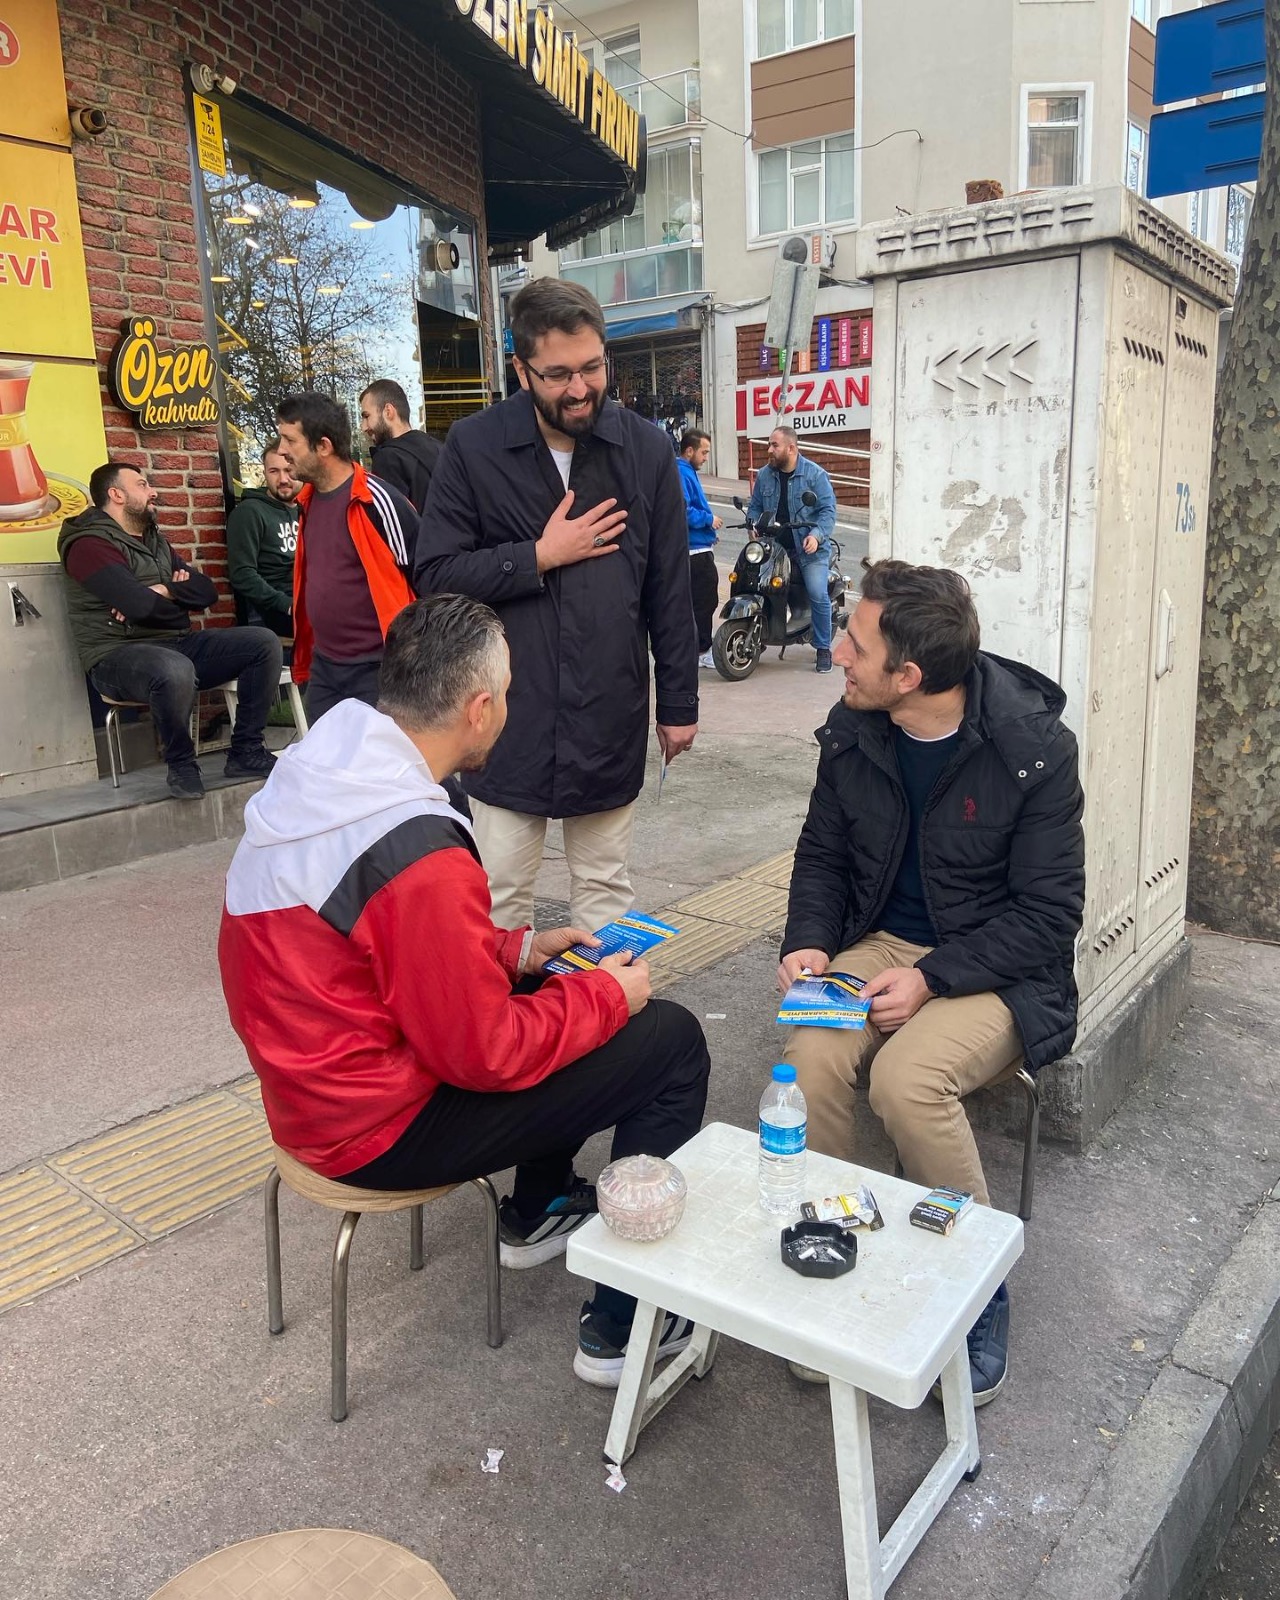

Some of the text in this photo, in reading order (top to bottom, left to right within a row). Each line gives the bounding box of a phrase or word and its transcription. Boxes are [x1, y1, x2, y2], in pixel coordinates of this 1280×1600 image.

[454, 0, 640, 172] EN SİMİT FIRINI
[0, 203, 61, 244] AR
[861, 326, 869, 354] MEDİKAL
[120, 320, 213, 406] Özen
[820, 343, 828, 366] KİŞİSEL
[753, 374, 870, 417] ECZAN
[145, 396, 218, 425] kahvaltı
[792, 413, 847, 430] BULVAR
[277, 521, 299, 538] JAC
[281, 536, 298, 552] JO
